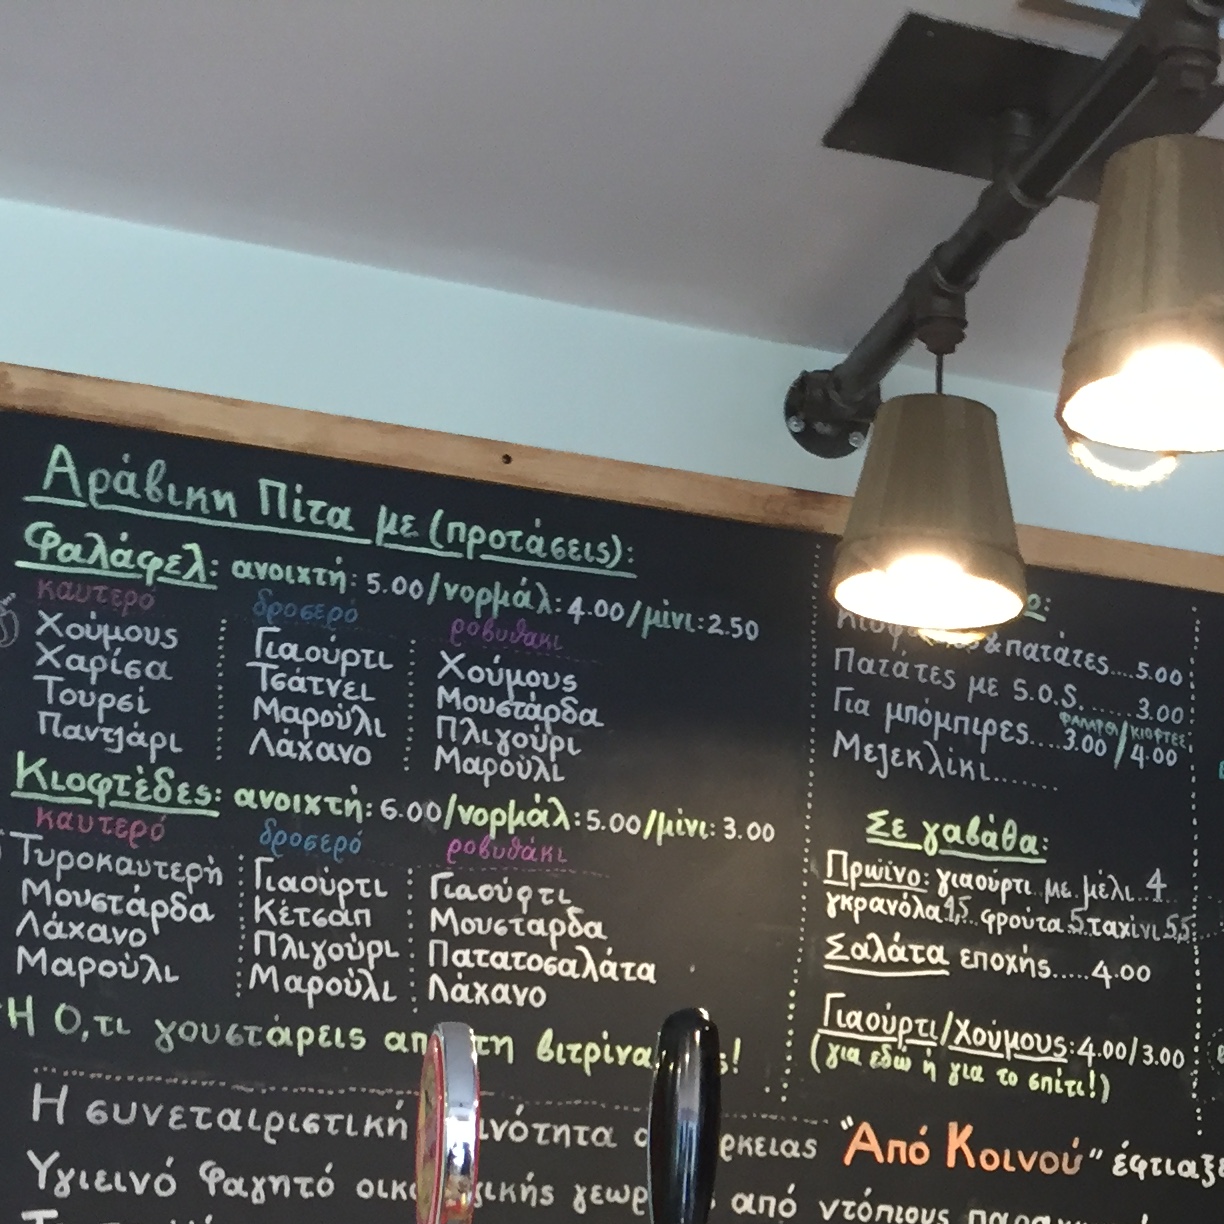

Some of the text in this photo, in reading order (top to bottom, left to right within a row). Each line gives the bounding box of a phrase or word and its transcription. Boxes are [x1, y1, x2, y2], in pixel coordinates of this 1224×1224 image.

[258, 477, 355, 532] Πίτα
[376, 505, 419, 545] με
[35, 609, 178, 652] Χούμους
[253, 626, 394, 677] Γιαούρτι
[35, 641, 173, 685] Χαρίσα
[437, 650, 578, 700] Χούμους
[834, 646, 956, 690] Πατάτες
[968, 675, 999, 703] με
[33, 675, 150, 722] Τουρσί
[253, 696, 387, 738] Μαρούλι
[437, 685, 604, 734] Μουστάρδα
[834, 686, 871, 716] Για
[38, 711, 182, 763] Παντζάρι
[249, 727, 372, 766] Λάχανο
[436, 716, 582, 757] Πλιγούρι
[435, 746, 565, 787] Μαρούλι
[723, 816, 775, 842] 3.00
[866, 810, 908, 839] Σε
[10, 831, 224, 893] Τυροκαυτερή
[254, 857, 388, 908] Γιαούρτι
[22, 878, 215, 935] Μουστάρδα
[430, 872, 572, 914] Γιαούρτι
[16, 910, 146, 947] Λάχανο
[254, 930, 400, 970] Πλιγούρι
[823, 931, 950, 967] Σαλάτα
[16, 945, 179, 988] Μαρούλι
[428, 939, 657, 984] Πατατοσαλάτα
[249, 963, 397, 1009] Μαρούλι
[428, 971, 547, 1008] Λάχανο
[155, 1013, 366, 1057] γουστάρεις
[948, 1062, 985, 1087] για
[996, 1067, 1018, 1087] το
[32, 1083, 69, 1125] Η
[86, 1099, 408, 1144] συνεταιριστική
[27, 1149, 177, 1198] Υγιεινό
[731, 1183, 798, 1218] από
